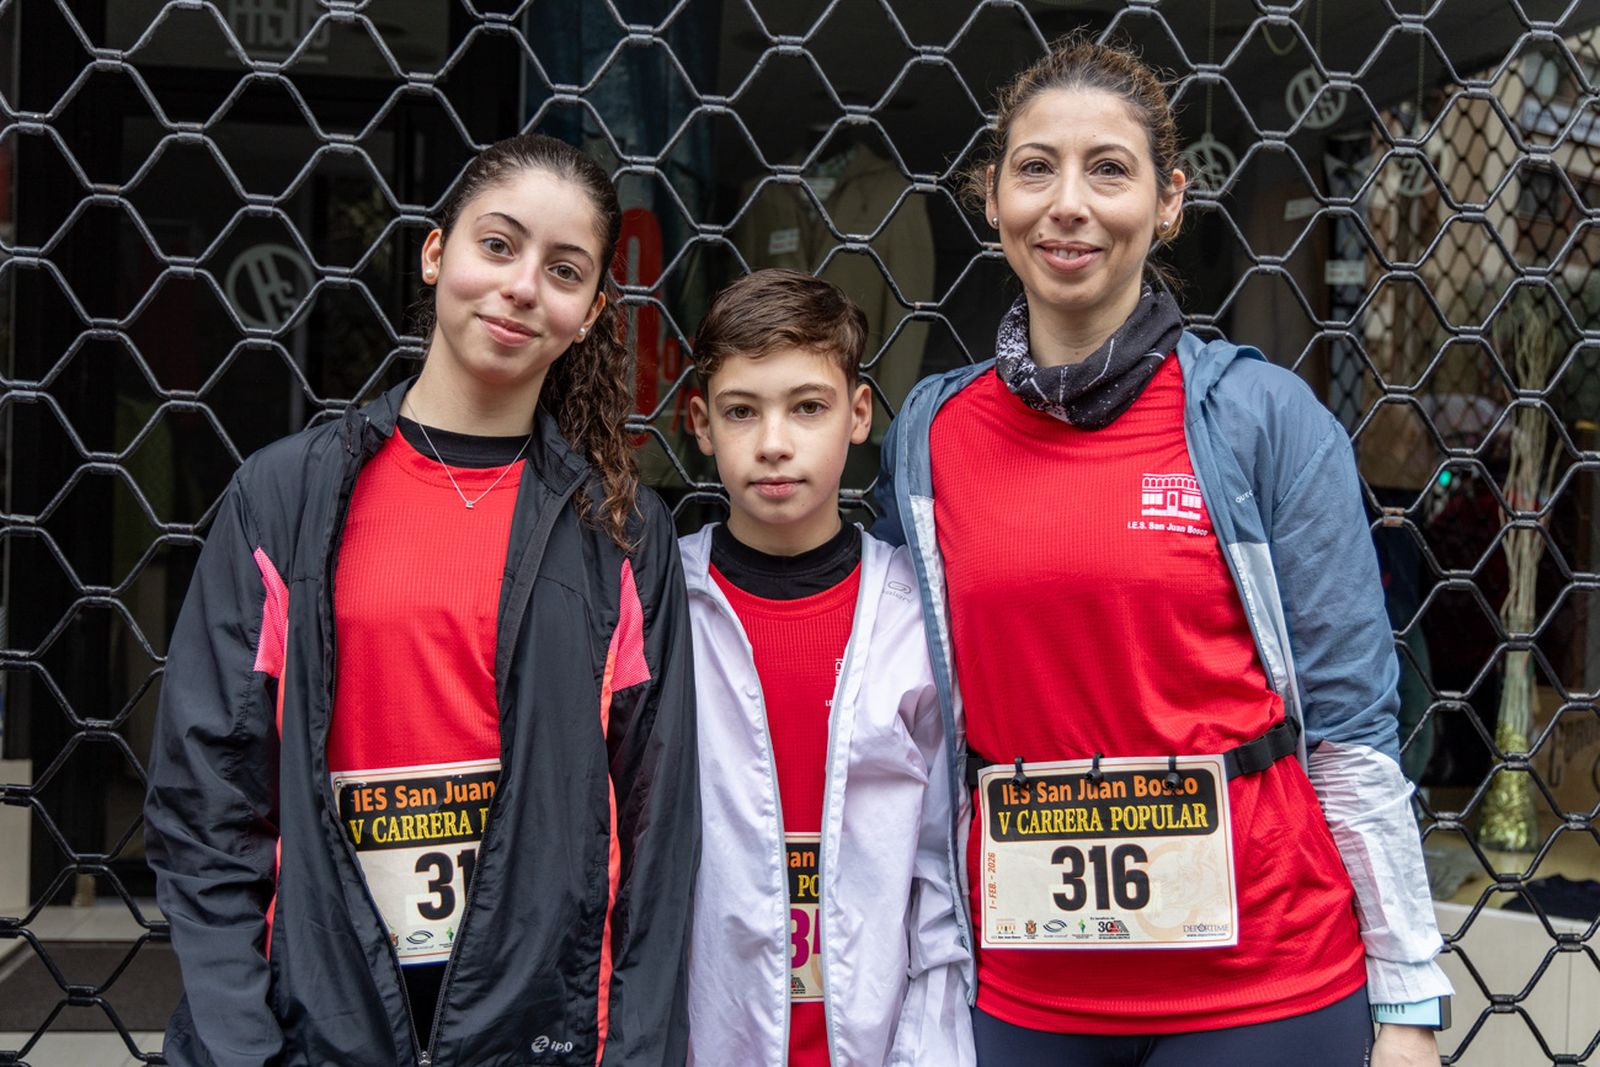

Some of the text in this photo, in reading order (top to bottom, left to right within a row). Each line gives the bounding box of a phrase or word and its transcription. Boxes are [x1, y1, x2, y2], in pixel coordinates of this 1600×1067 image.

[1149, 522, 1165, 530] San
[1167, 523, 1186, 533] Juan
[1187, 525, 1208, 536] Bosco
[353, 780, 495, 812] IES San Juan
[1002, 783, 1031, 805] IES
[1037, 781, 1072, 803] San
[1078, 778, 1126, 800] Juan
[349, 819, 364, 845] V
[372, 809, 473, 843] CARRERA
[998, 803, 1209, 835] V CARRERA POPULAR
[1051, 843, 1150, 911] 316
